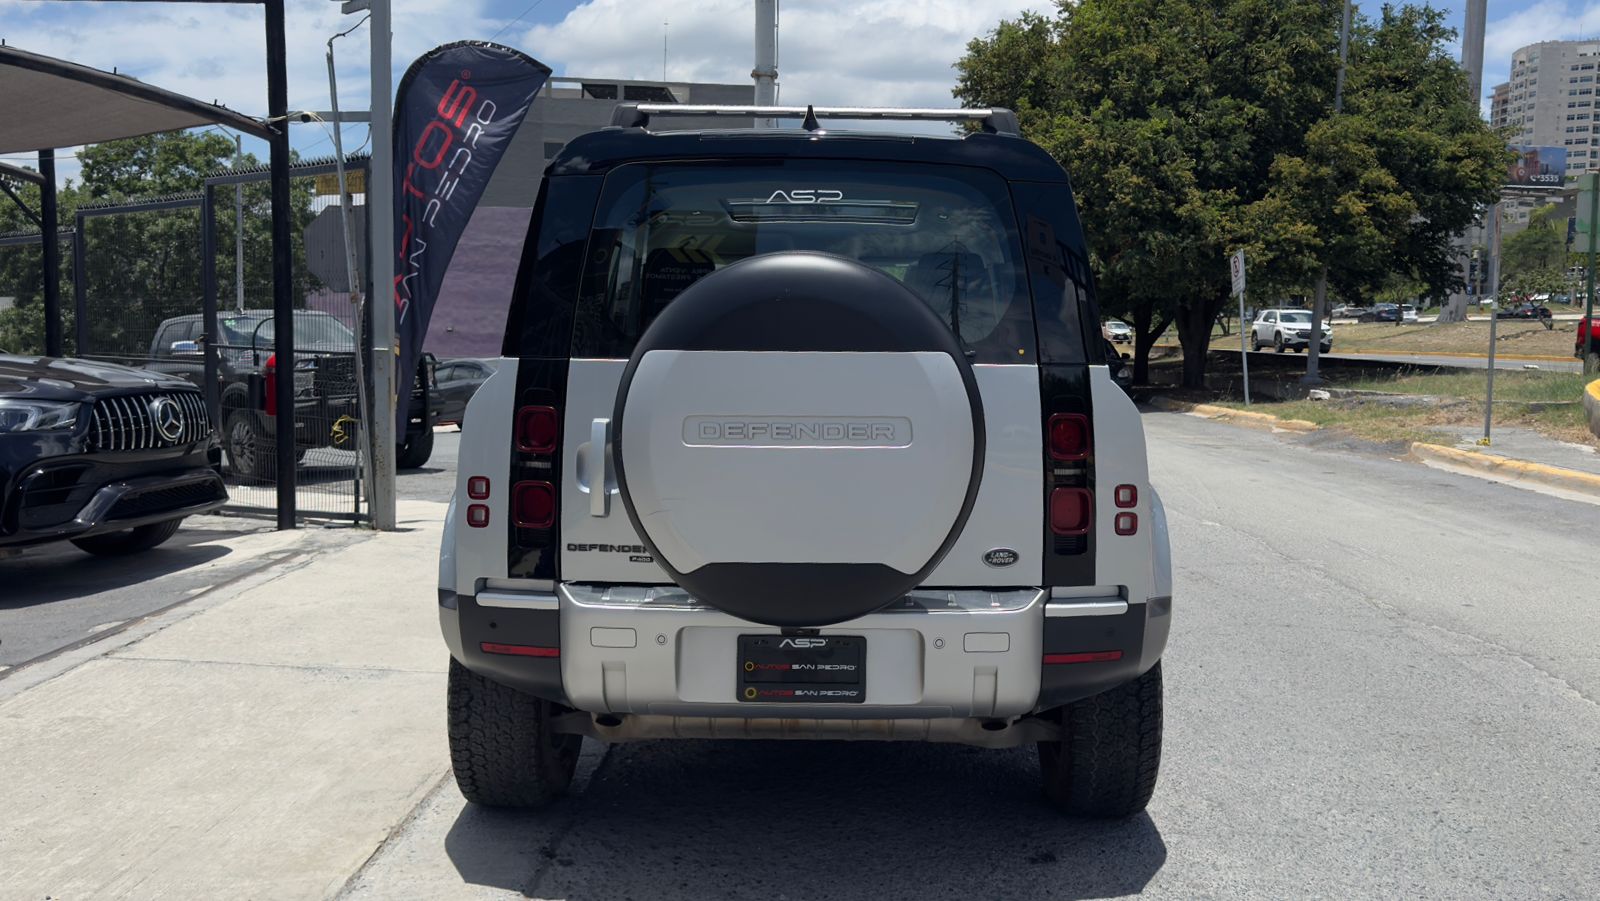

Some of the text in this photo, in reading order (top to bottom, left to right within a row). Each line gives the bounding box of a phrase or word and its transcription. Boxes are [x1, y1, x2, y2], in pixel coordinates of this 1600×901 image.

[422, 99, 497, 228] PEDRO
[766, 190, 843, 204] ASP
[699, 420, 896, 441] DEFENDER
[779, 639, 827, 648] ASP
